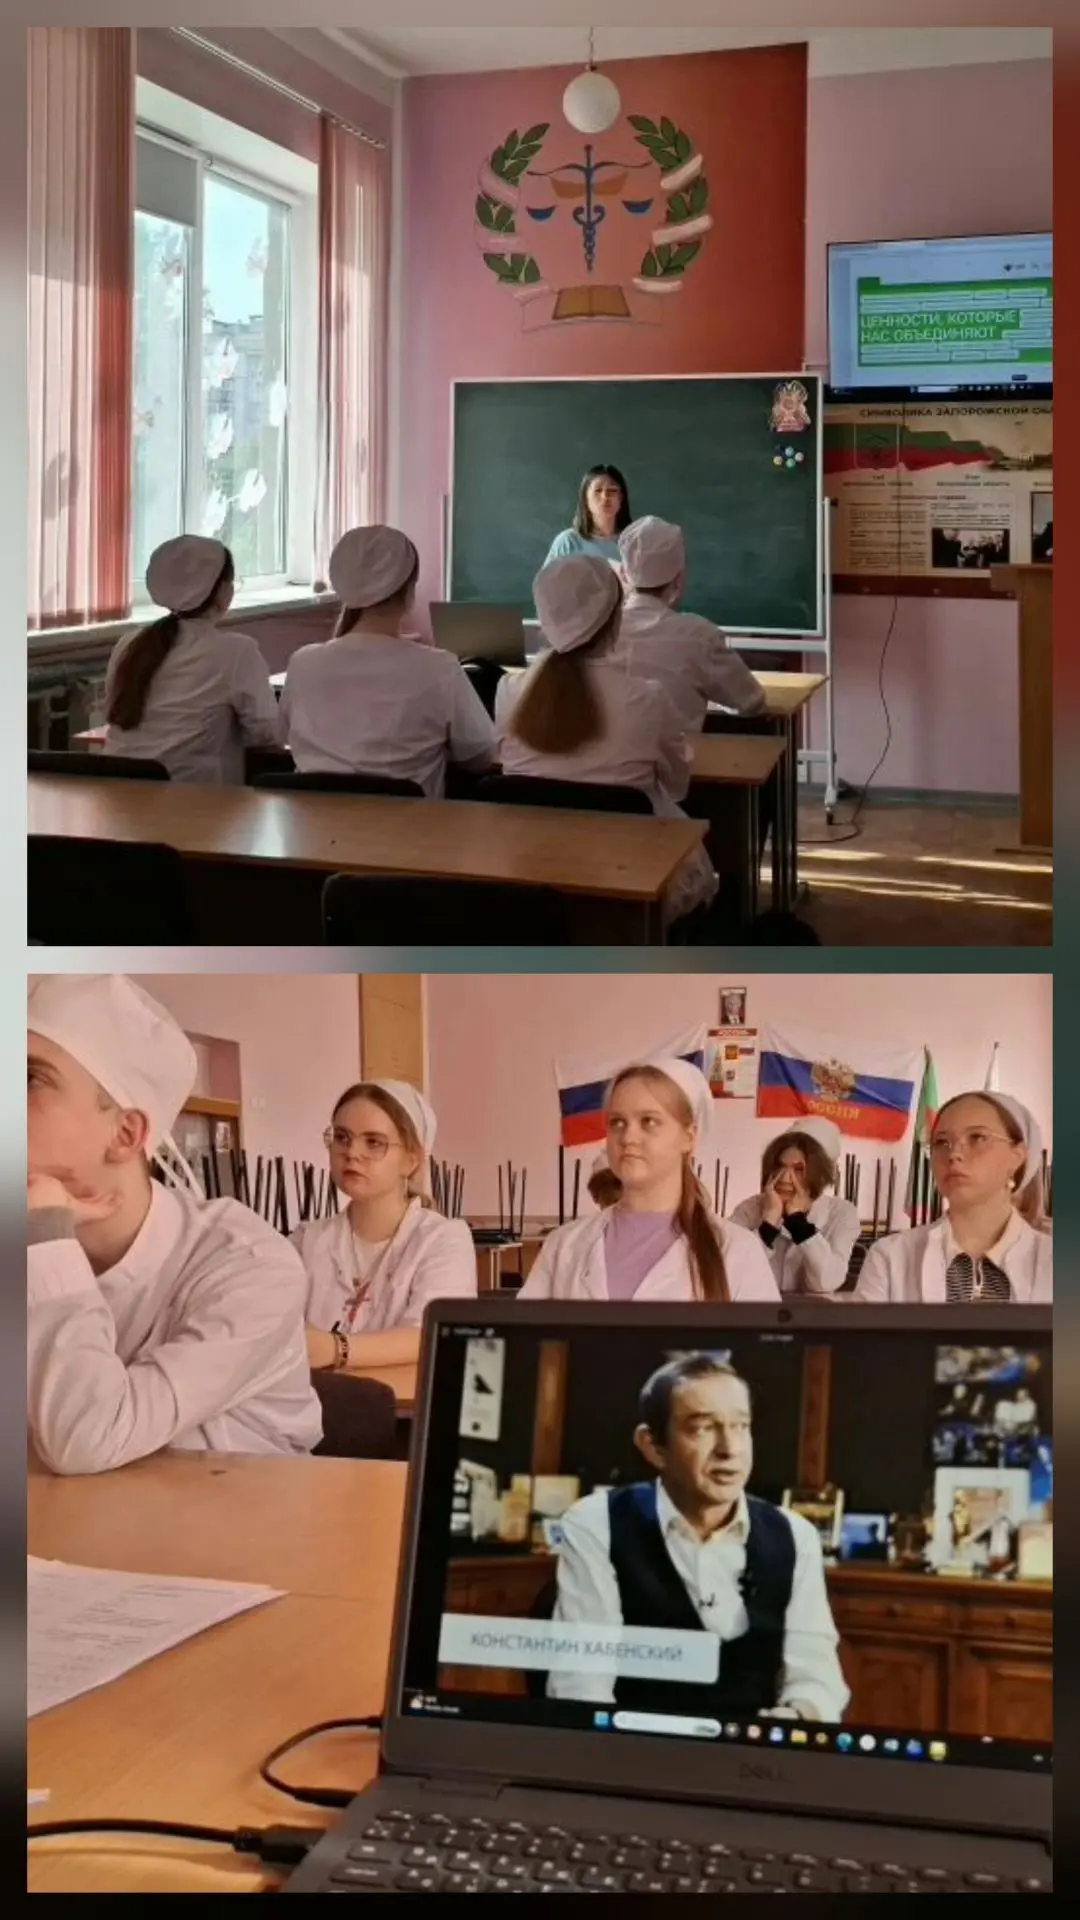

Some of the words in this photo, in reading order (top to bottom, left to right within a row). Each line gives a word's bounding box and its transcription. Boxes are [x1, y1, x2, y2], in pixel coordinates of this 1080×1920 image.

[947, 309, 1018, 323] КОТОРЫЕ
[860, 330, 889, 343] НАС
[893, 326, 996, 342] ОБЪЕДИНЯЮТ
[859, 407, 933, 417] СИМВОЛИКА
[471, 1631, 579, 1653] КОНСТАНТИН
[583, 1640, 683, 1661] ХАБЕНСКИЙ
